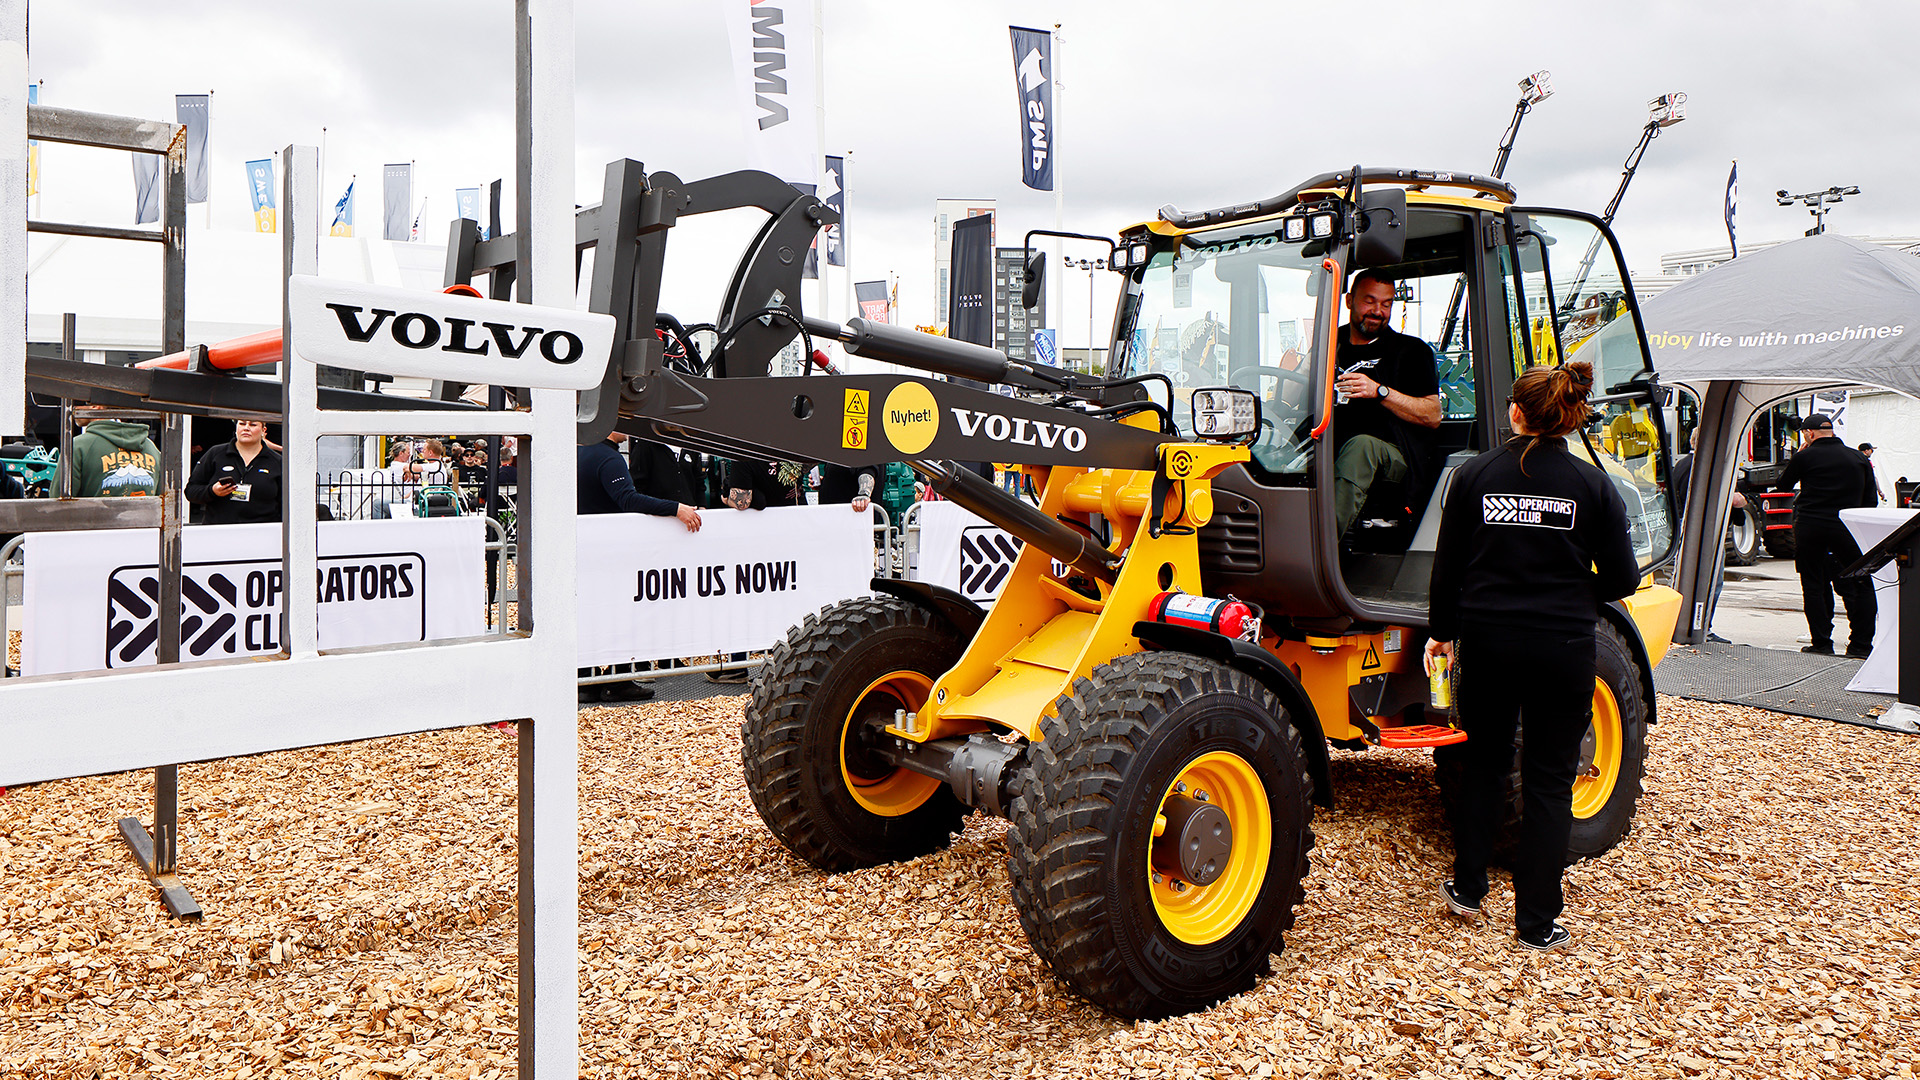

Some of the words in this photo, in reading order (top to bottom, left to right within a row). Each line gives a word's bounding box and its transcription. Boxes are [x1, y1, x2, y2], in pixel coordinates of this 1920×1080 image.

[750, 0, 789, 131] MMA
[1182, 235, 1279, 262] VOLVO
[326, 302, 585, 365] VOLVO
[1644, 331, 1694, 349] njoy
[1698, 332, 1733, 347] life
[1739, 331, 1788, 347] with
[1793, 324, 1905, 345] machines
[891, 408, 932, 427] Nyhet!
[950, 407, 1088, 452] VOLVO
[1518, 498, 1572, 515] OPERATORS
[1518, 510, 1542, 524] CLUB
[246, 563, 414, 608] OPATORS
[633, 567, 687, 602] JOIN
[697, 565, 726, 597] US
[735, 560, 797, 594] NOW!
